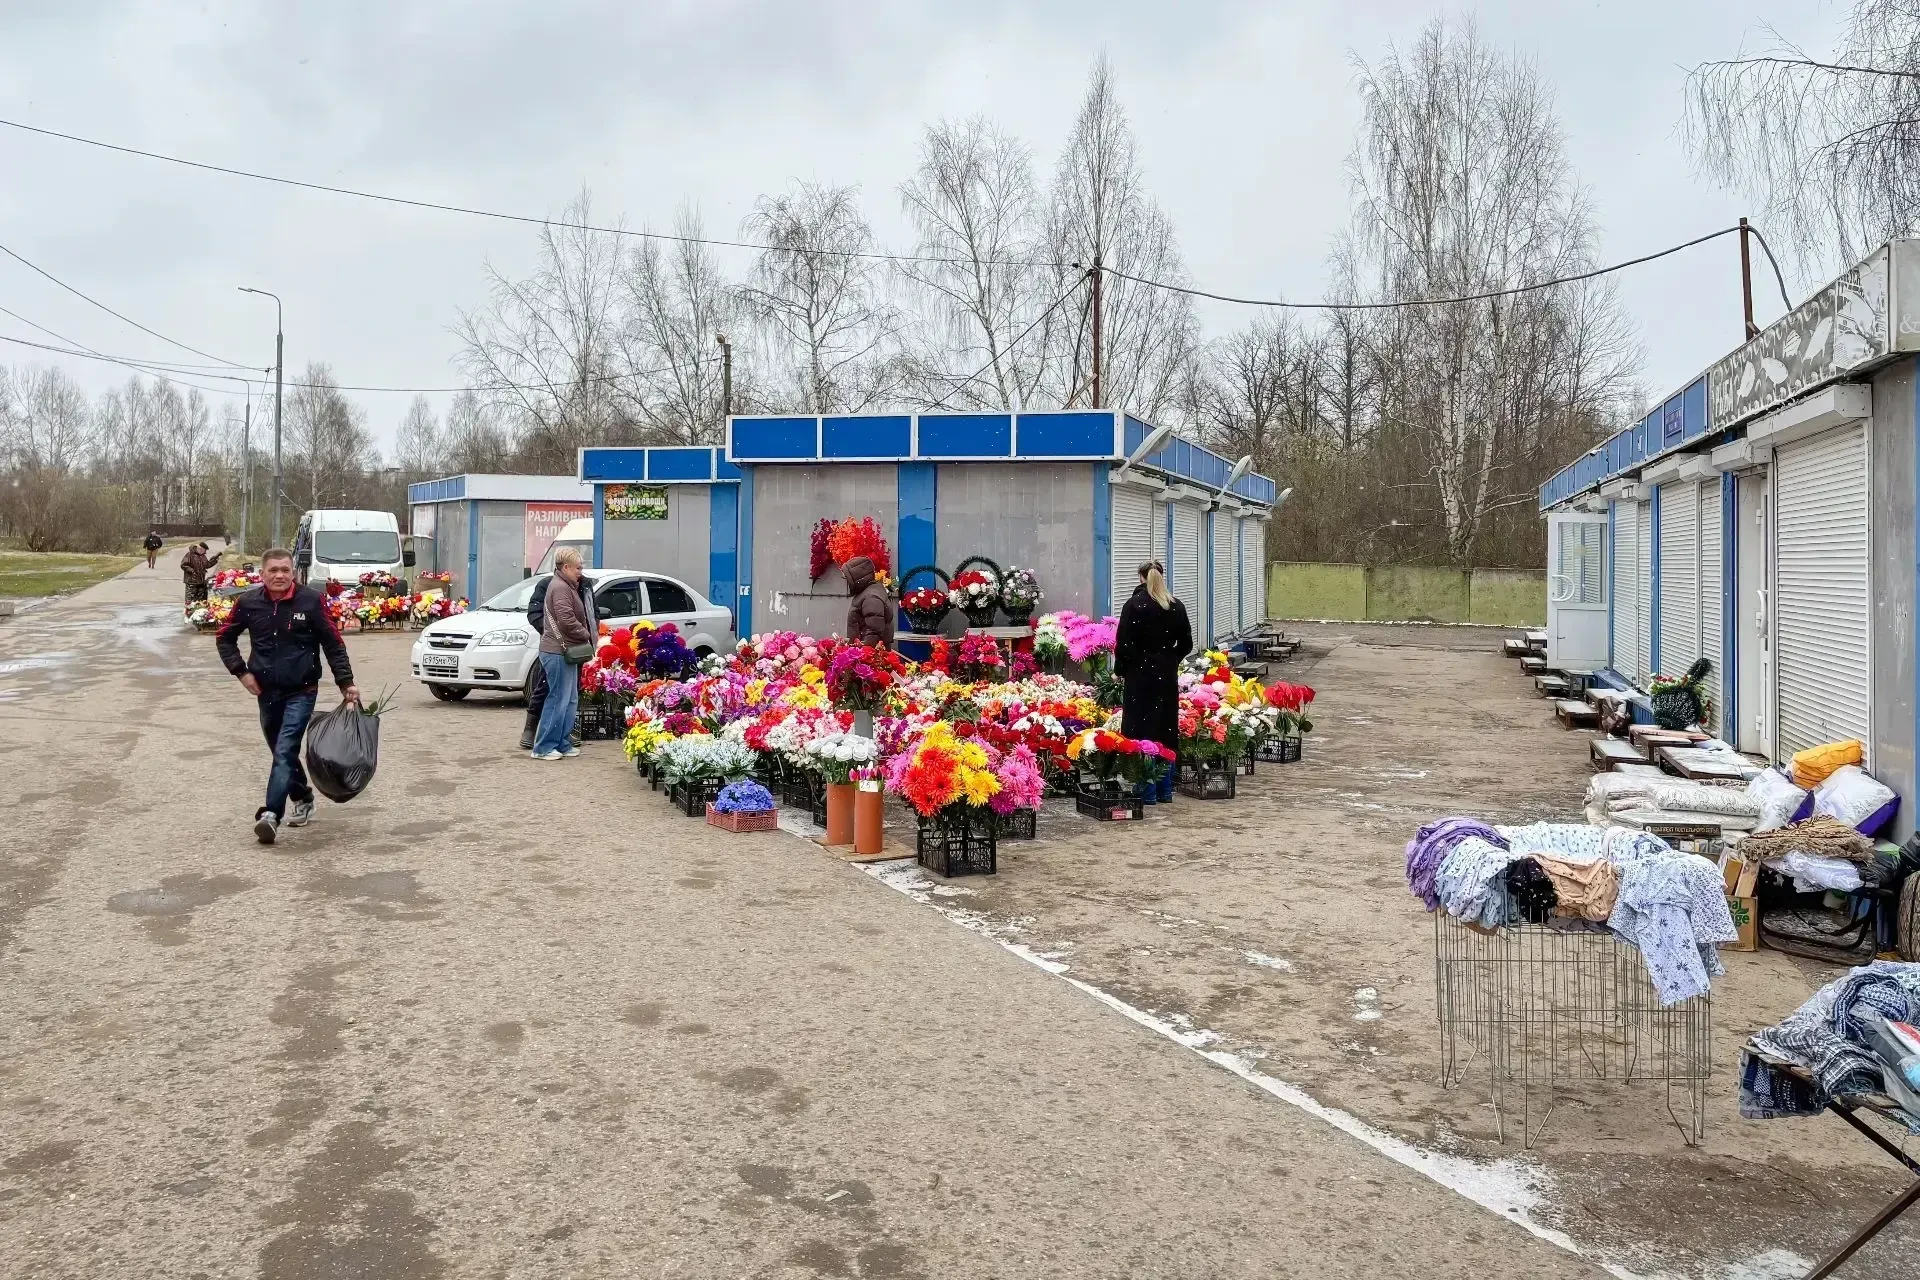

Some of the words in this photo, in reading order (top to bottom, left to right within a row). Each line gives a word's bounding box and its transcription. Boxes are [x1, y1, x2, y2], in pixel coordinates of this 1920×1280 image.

[607, 497, 635, 506] ФРУКТЫ
[641, 497, 665, 506] ОВОЩИ
[293, 612, 306, 621] FILA
